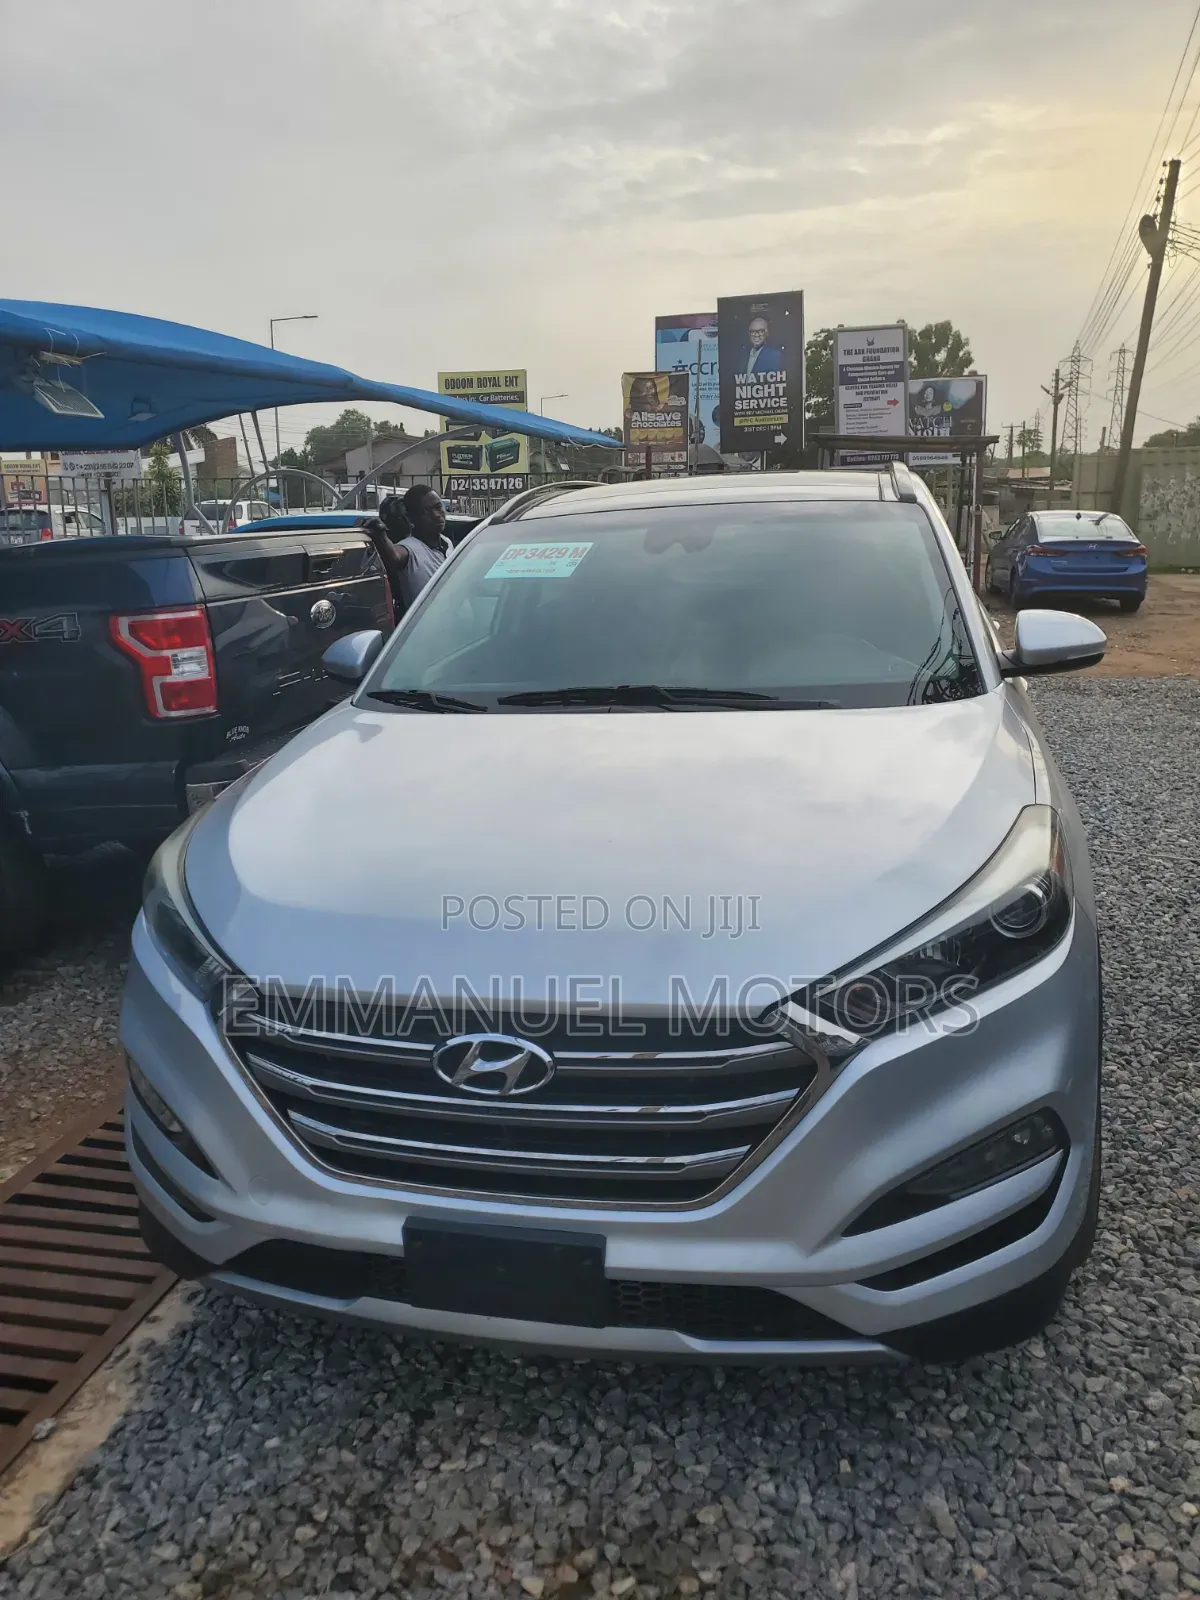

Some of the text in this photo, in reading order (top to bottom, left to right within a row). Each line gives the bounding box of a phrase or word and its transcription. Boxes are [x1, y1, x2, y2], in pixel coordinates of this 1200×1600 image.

[866, 346, 900, 354] FOUNDATION
[672, 359, 720, 375] Accr
[445, 376, 518, 389] ODOOM ROYAL ENT
[734, 370, 786, 384] WATCH
[736, 383, 786, 399] NIGHT
[735, 397, 787, 410] SERVICE
[631, 412, 681, 421] Allsave
[452, 478, 523, 491] 0243347126
[524, 547, 569, 559] 3429
[568, 547, 589, 558] M
